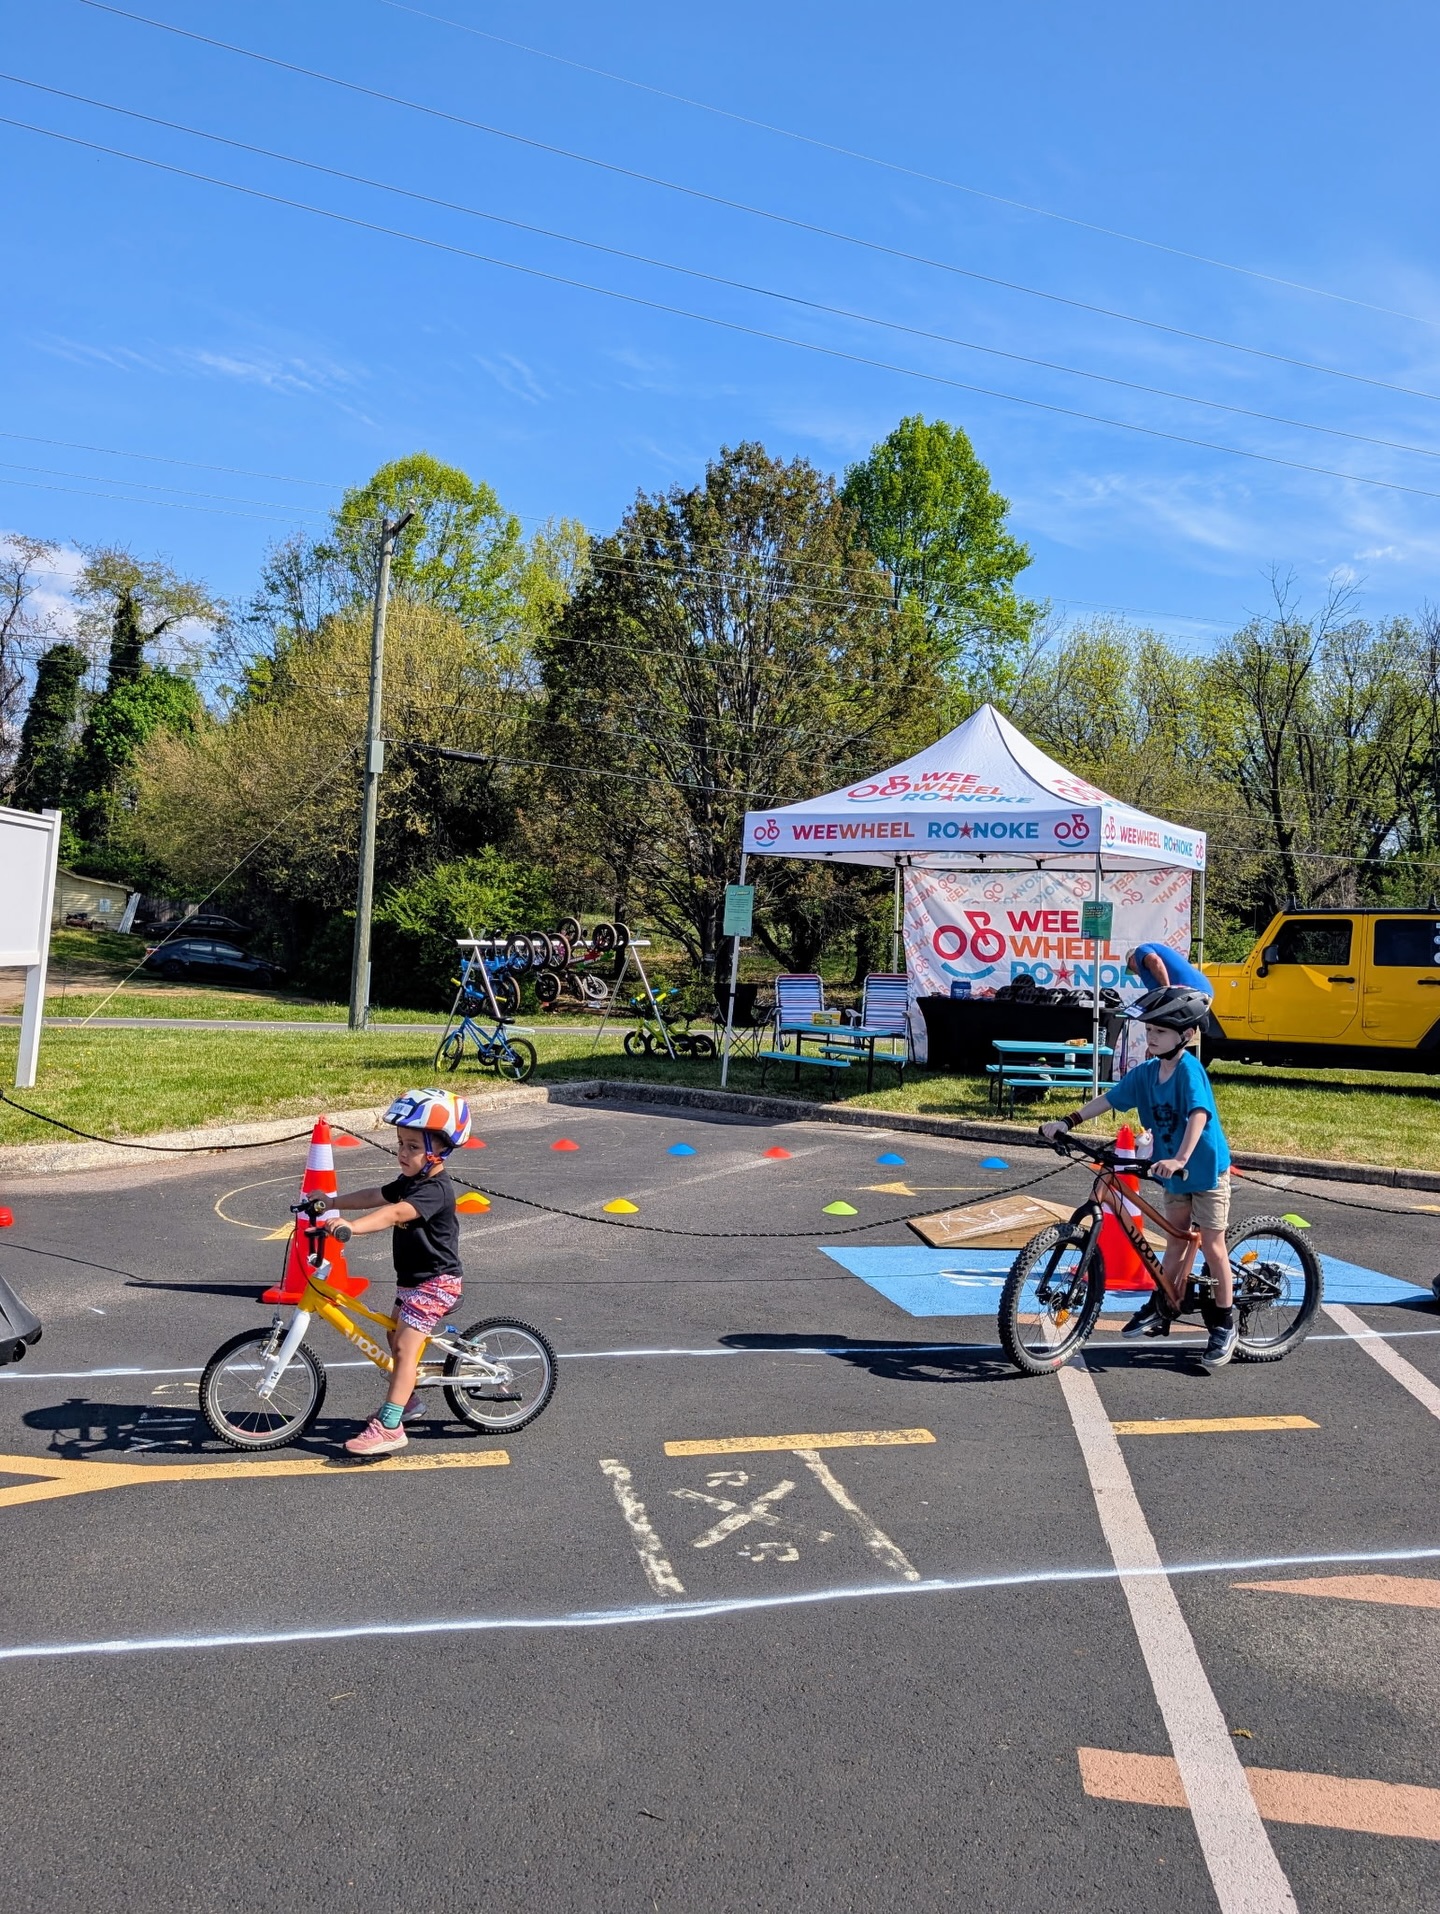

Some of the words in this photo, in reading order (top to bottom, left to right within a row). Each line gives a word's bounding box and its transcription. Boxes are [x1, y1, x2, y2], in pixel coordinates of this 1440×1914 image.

[921, 771, 980, 783] WEE
[912, 783, 1004, 795] WHEEL
[792, 822, 915, 840] WEEWHEEL
[1120, 825, 1161, 848] WEEWHEEL
[1006, 910, 1080, 933] WEE
[1008, 936, 1121, 961] WHEEL
[270, 1370, 279, 1380] 14
